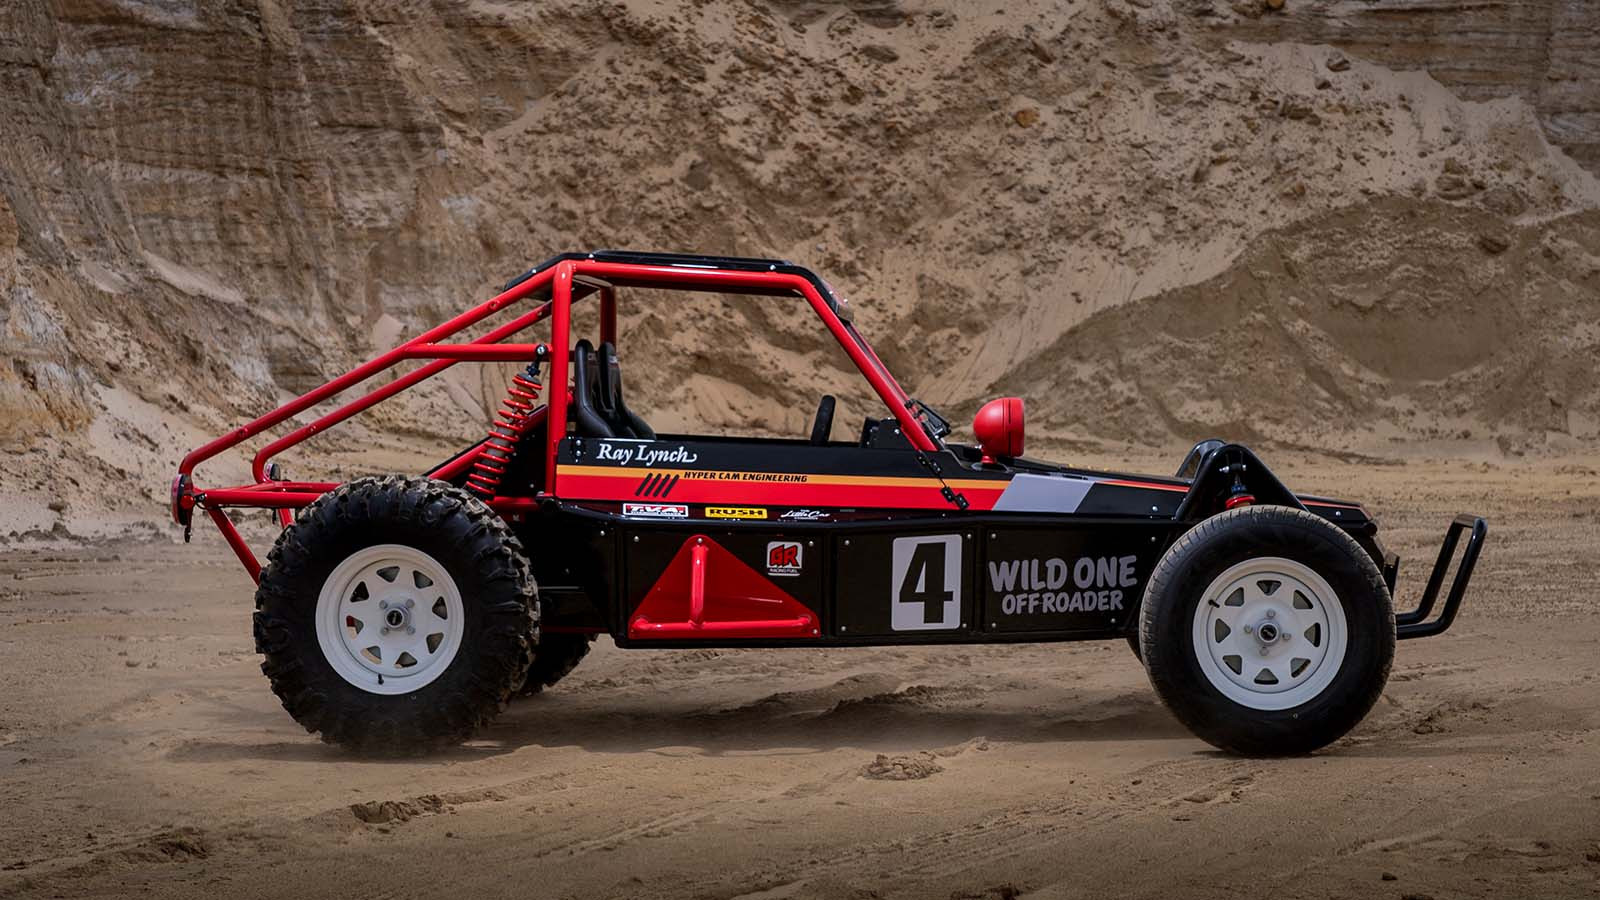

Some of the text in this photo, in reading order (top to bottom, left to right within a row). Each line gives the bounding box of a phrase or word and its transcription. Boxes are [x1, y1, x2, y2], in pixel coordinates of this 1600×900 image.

[596, 443, 698, 467] Ray Lynch
[684, 471, 716, 479] HYPER
[742, 474, 808, 483] ENGINEERING
[899, 541, 953, 624] 4
[988, 555, 1138, 592] WILD ONE
